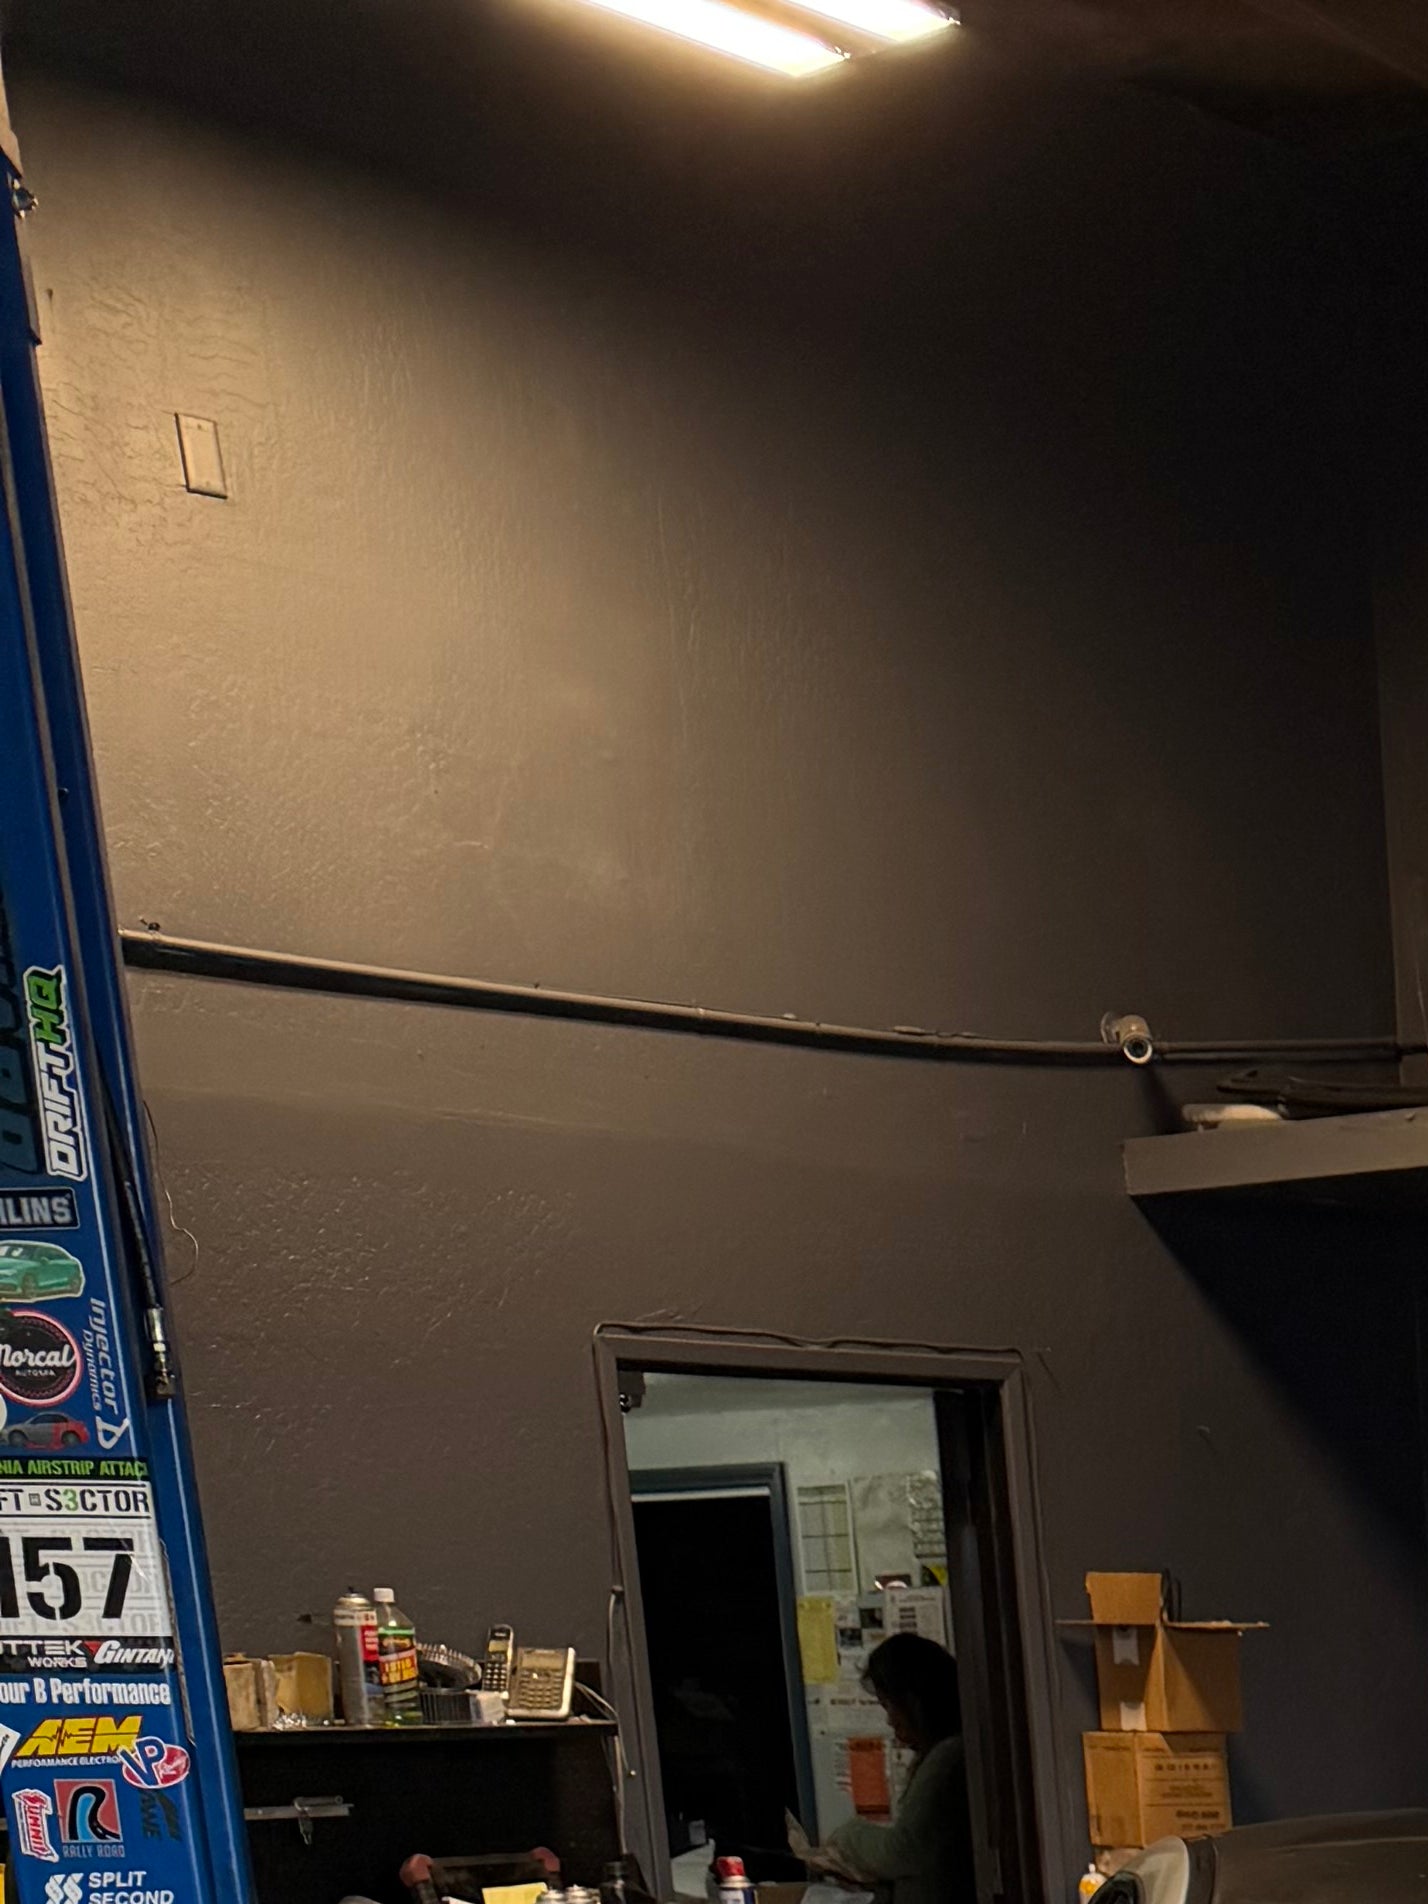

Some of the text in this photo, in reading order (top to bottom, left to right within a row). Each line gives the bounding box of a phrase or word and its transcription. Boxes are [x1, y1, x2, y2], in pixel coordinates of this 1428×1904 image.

[91, 1297, 119, 1415] Injector
[28, 1461, 94, 1475] AIRSTRIP
[27, 1656, 88, 1669] WORKS
[34, 1678, 47, 1704] B
[51, 1677, 171, 1705] Performance
[14, 1715, 144, 1758] AEM
[11, 1757, 78, 1769] PERFORMANCE
[88, 1871, 147, 1888] SPLIT
